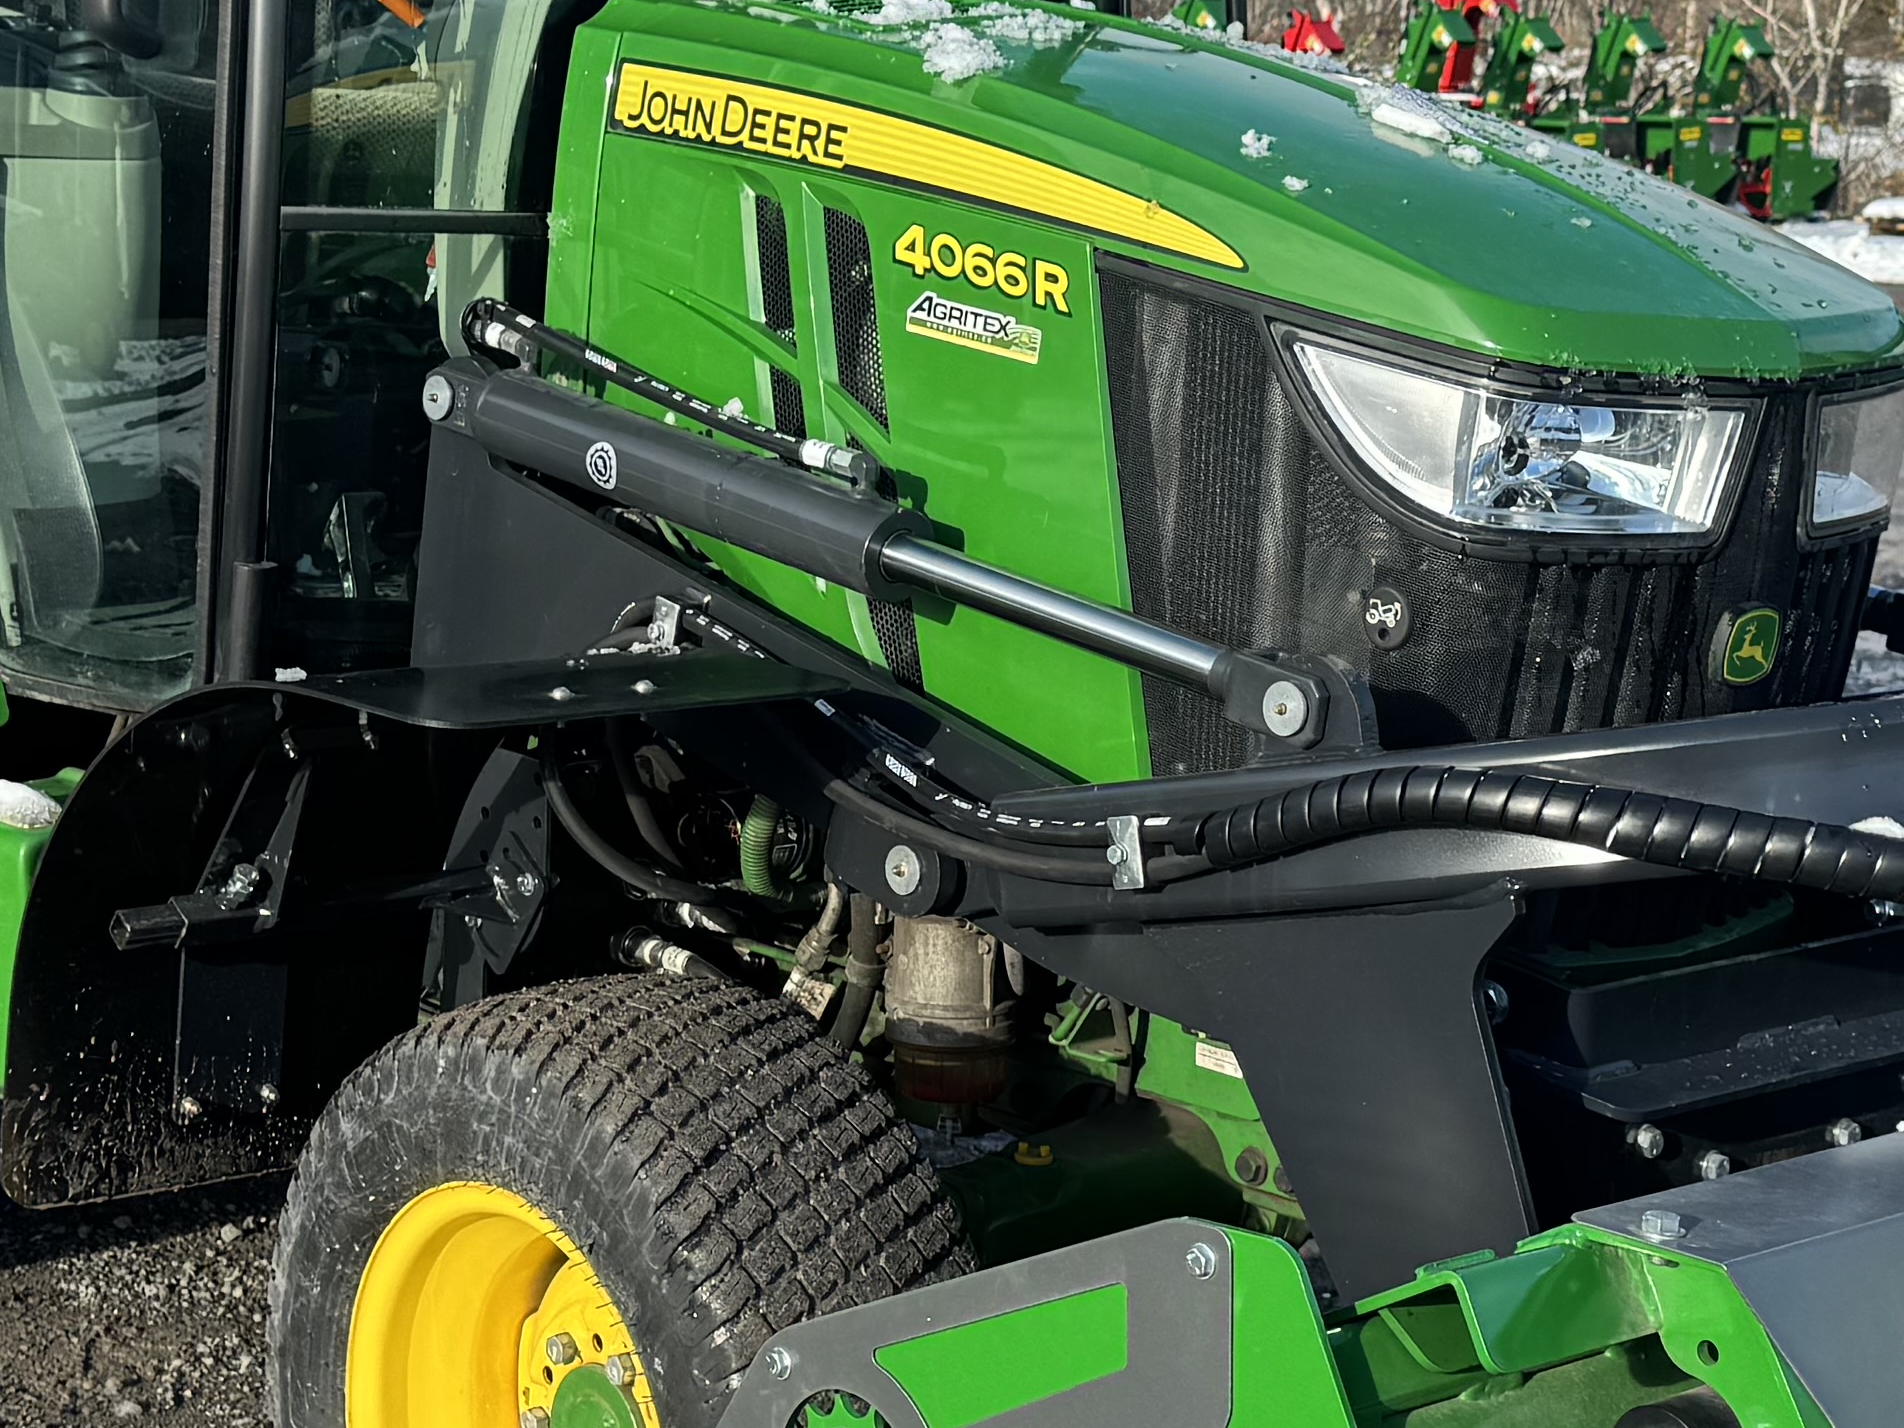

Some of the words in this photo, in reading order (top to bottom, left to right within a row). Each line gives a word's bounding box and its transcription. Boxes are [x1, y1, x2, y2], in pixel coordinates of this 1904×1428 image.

[627, 80, 716, 136] JOHN
[720, 94, 848, 162] DEERE
[911, 296, 1012, 338] AGRITEX
